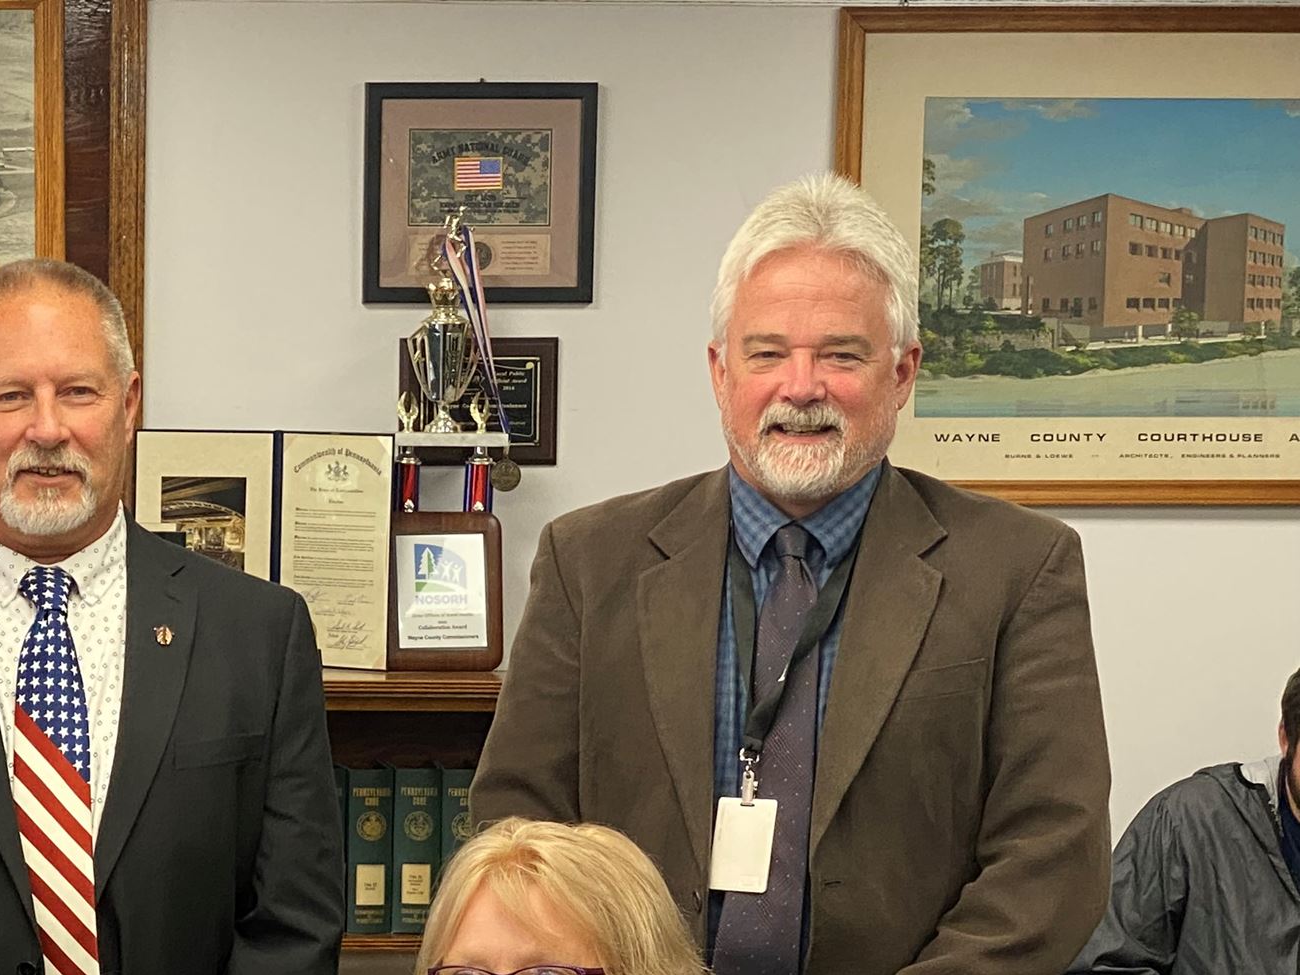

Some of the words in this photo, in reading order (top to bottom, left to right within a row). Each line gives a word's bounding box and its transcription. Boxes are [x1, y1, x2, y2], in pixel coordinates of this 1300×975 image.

[934, 433, 1001, 442] WAYNE
[1030, 433, 1107, 442] COUNTY
[1137, 433, 1264, 442] COURTHOUSE
